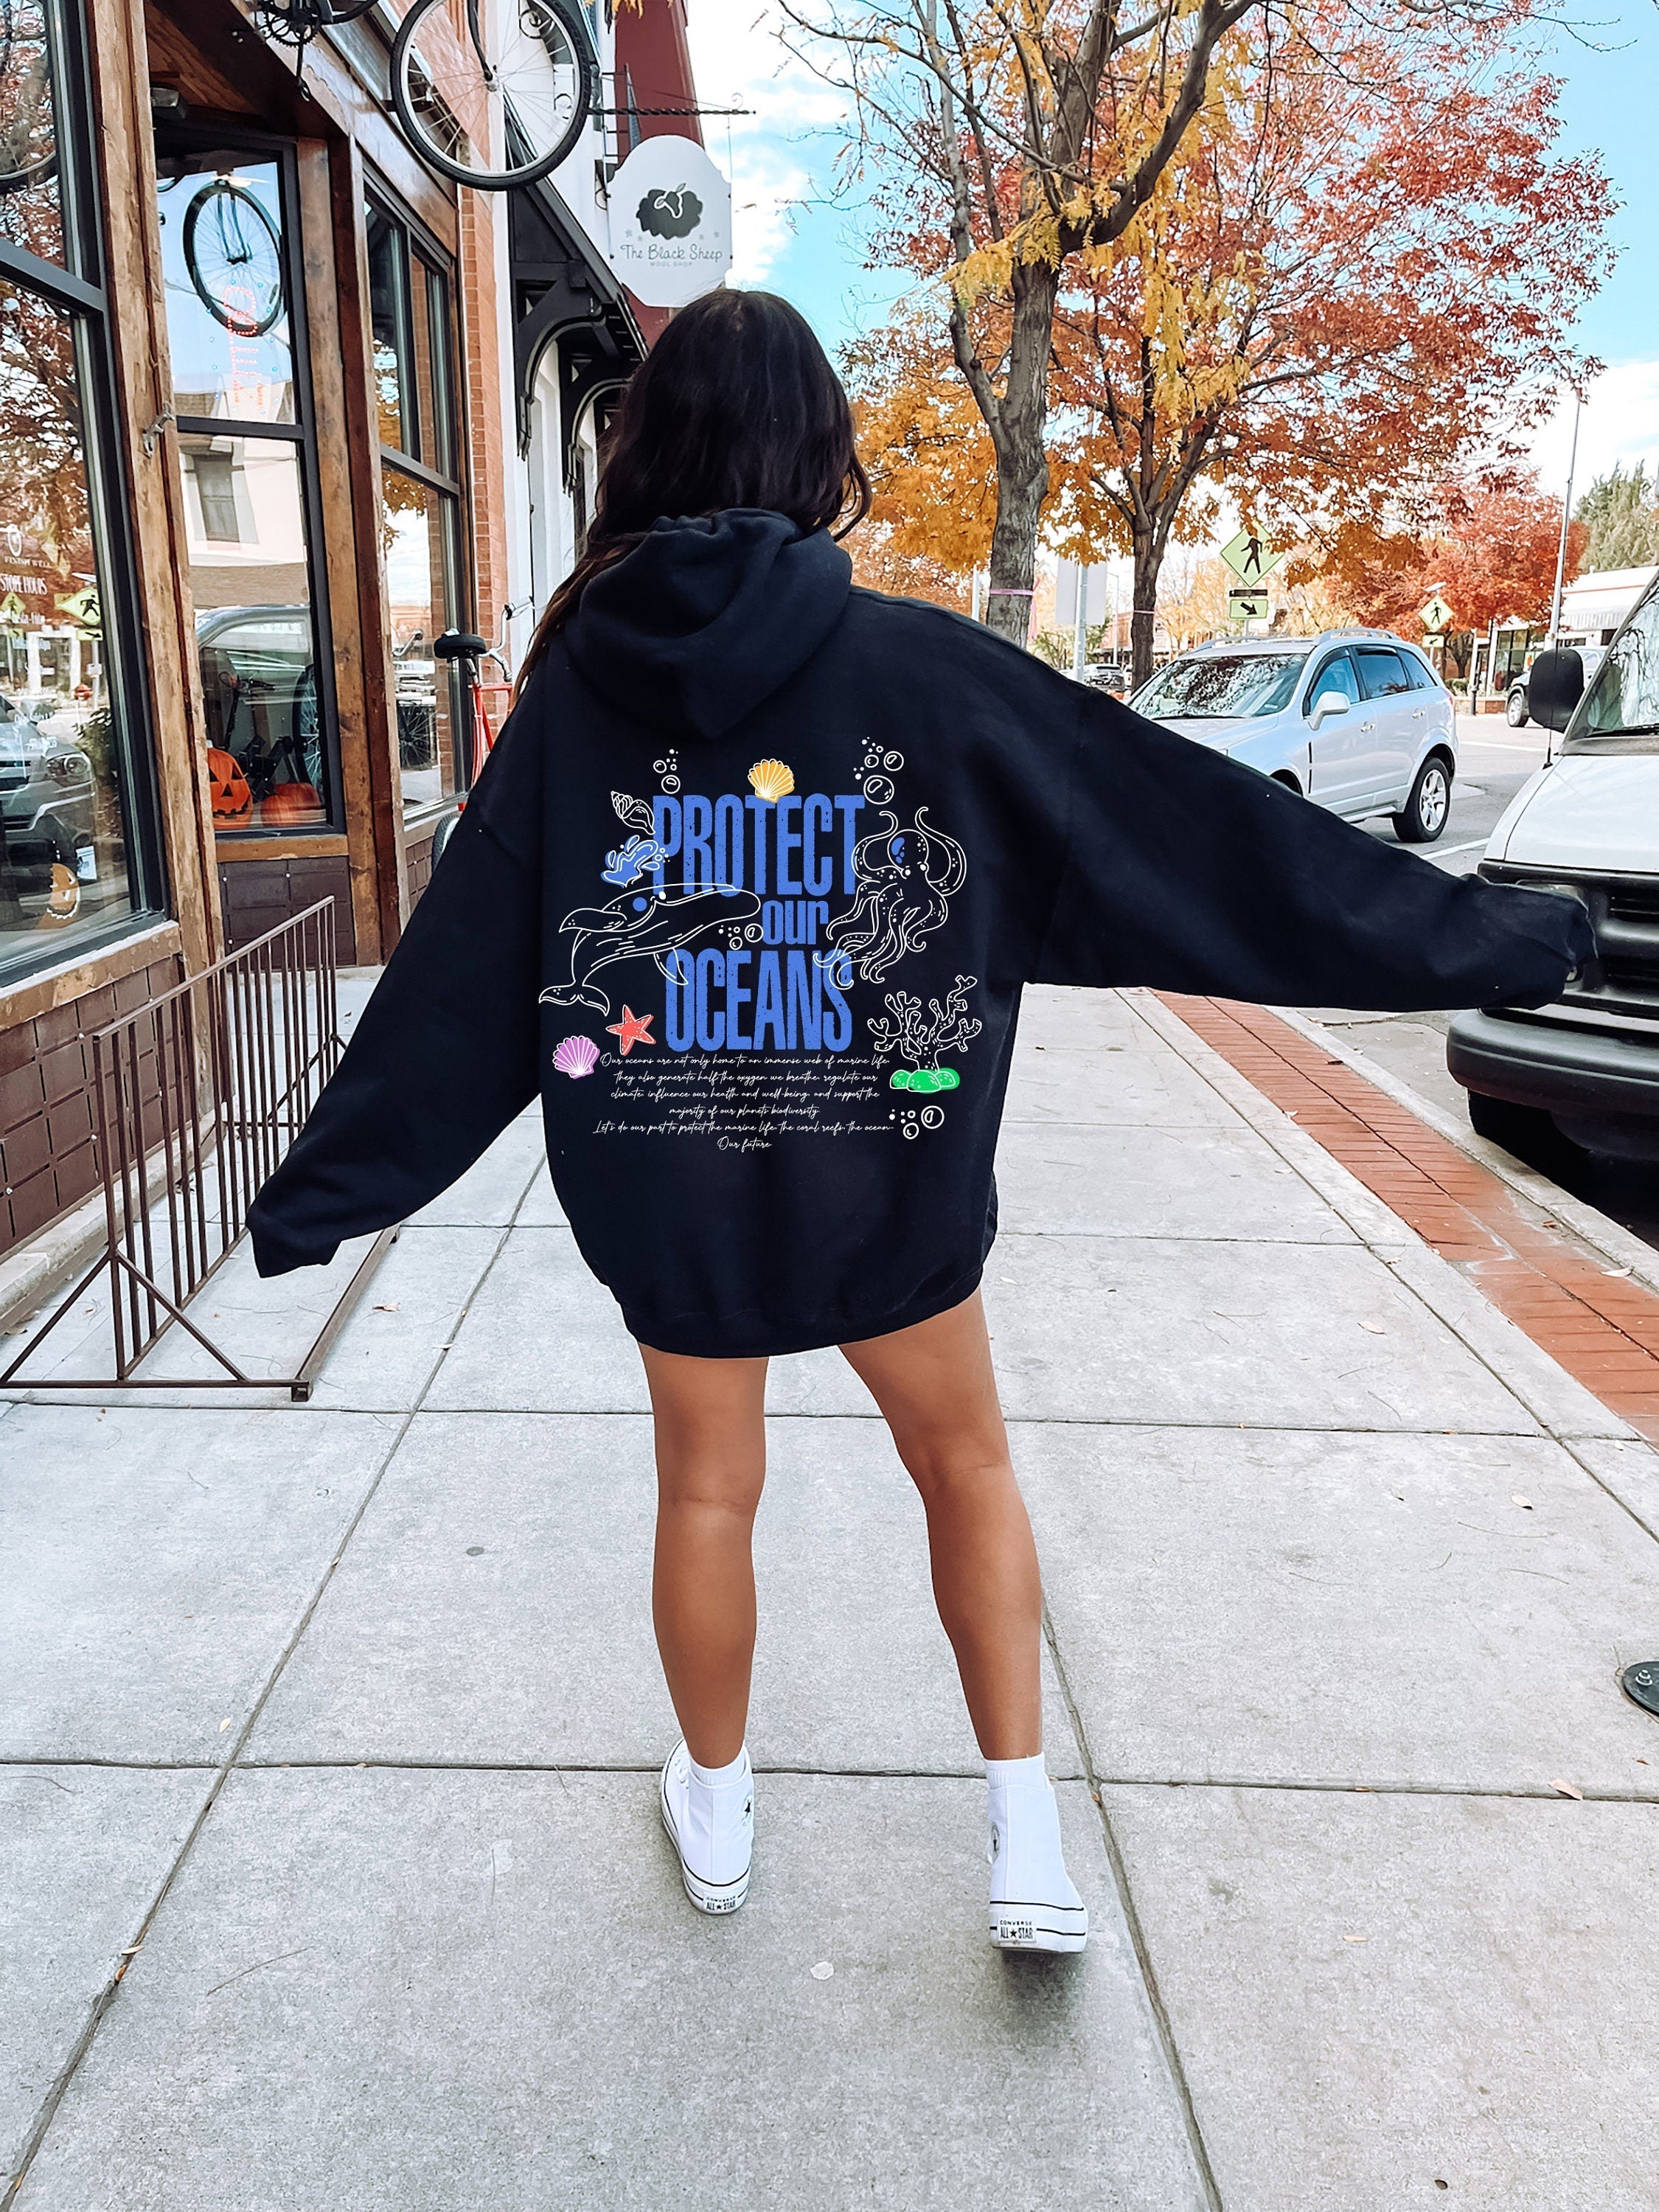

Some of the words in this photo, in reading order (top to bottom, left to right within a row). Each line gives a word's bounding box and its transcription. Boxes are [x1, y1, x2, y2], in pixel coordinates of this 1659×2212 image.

[620, 244, 643, 259] The
[648, 244, 686, 260] Black
[689, 243, 723, 262] Sheep
[653, 793, 865, 897] PROTECT
[665, 948, 852, 1052] OCEANS
[599, 1052, 623, 1067] Our
[673, 1053, 694, 1068] not
[690, 1054, 710, 1069] only
[712, 1054, 735, 1064] home
[735, 1054, 748, 1068] to
[804, 1054, 822, 1064] web
[824, 1054, 835, 1069] of
[837, 1057, 869, 1065] marine
[613, 1070, 636, 1086] they
[638, 1071, 656, 1082] also
[656, 1070, 698, 1086] generate
[698, 1071, 718, 1086] half
[718, 1070, 734, 1084] the
[737, 1075, 768, 1086] oxygen
[824, 1071, 861, 1086] regulate
[647, 1087, 690, 1102] influence
[711, 1087, 739, 1101] health
[741, 1087, 759, 1099] and
[814, 1087, 832, 1099] and
[834, 1087, 864, 1102] support
[863, 1087, 880, 1101] the
[669, 1104, 706, 1119] majority
[708, 1105, 718, 1119] of
[618, 1121, 628, 1133] do
[647, 1121, 667, 1135] part
[667, 1121, 678, 1134] to
[678, 1120, 707, 1135] protect
[707, 1120, 722, 1134] the
[777, 1120, 794, 1134] the
[796, 1121, 819, 1132] coral
[846, 1120, 863, 1134] the
[717, 1136, 740, 1150] Our
[706, 1902, 715, 1910] ALL
[723, 1901, 736, 1910] STAR
[1000, 1927, 1009, 1938] ALL
[1018, 1927, 1033, 1939] STAR
